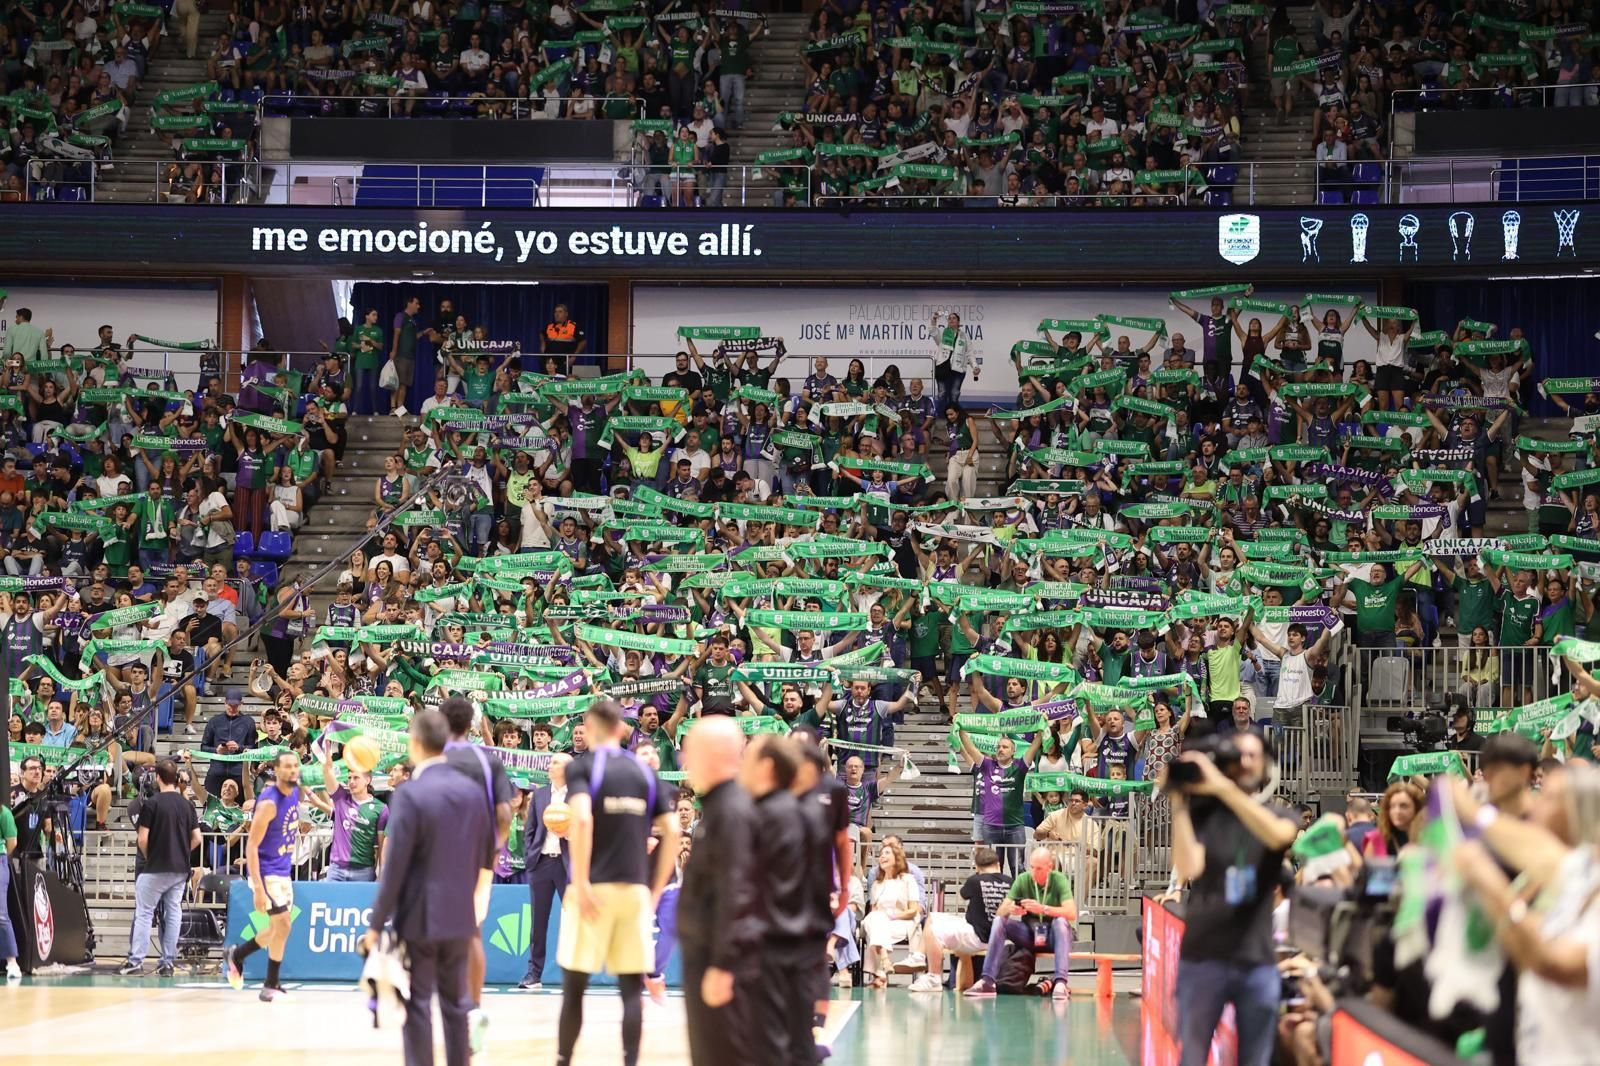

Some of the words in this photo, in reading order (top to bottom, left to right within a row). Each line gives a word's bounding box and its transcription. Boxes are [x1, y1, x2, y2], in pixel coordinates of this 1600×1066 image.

[1526, 28, 1550, 37] Unicaja
[806, 113, 857, 123] UNICAJA
[252, 227, 308, 251] me
[318, 222, 504, 262] emocioné,
[514, 230, 558, 263] yo
[568, 225, 688, 255] estuve
[698, 223, 762, 256] allí.
[850, 304, 899, 321] PALACIO
[903, 304, 918, 321] DE
[799, 322, 831, 340] JOSÉ
[860, 321, 913, 340] MARTÍN
[457, 340, 513, 350] UNICAJA
[723, 338, 779, 350] UNICAJA
[1480, 341, 1510, 349] Unicaja
[1095, 369, 1122, 381] Unicaja
[1154, 370, 1183, 378] Unicaja
[1555, 380, 1584, 389] Unicaja
[649, 387, 676, 395] Unicaja
[1134, 398, 1162, 410] Unicaja
[253, 418, 288, 432] BALONCESTO
[260, 415, 282, 425] UNICAJA
[136, 435, 164, 447] Unicaja
[165, 436, 208, 446] Baloncesto
[1108, 441, 1137, 449] Unicaja
[1044, 454, 1079, 464] BALONCESTO
[1283, 485, 1314, 493] Unicaja
[667, 498, 694, 508] Unicaja
[755, 508, 784, 516] Unicaja
[1303, 498, 1364, 520] UNICAJA
[62, 516, 92, 524] Unicaja
[1075, 529, 1106, 539] Unicaja
[822, 542, 855, 550] Unicaja
[1434, 539, 1492, 548] UNICAJA
[508, 554, 540, 563] Unicaja
[667, 562, 704, 570] BALONCESTO
[15, 577, 64, 586] Baloncesto
[790, 581, 823, 589] Unicaja
[951, 584, 982, 595] Unicaja
[1044, 583, 1072, 591] UNICAJA
[1039, 589, 1078, 597] BALONCESTO
[1086, 589, 1163, 606] UNICAJA
[1204, 597, 1237, 608] Unicaja
[112, 607, 139, 617] UNICAJA
[655, 609, 685, 619] UNICAJA
[1100, 610, 1132, 620] Unicaja
[1289, 608, 1325, 617] Baloncesto
[108, 611, 147, 626] BALONCESTO
[475, 614, 510, 624] Unicaja
[790, 614, 824, 622] Unicaja
[1027, 614, 1060, 623] Unicaja
[374, 625, 410, 634] Unicaja
[621, 630, 655, 644] Unicaja
[401, 640, 474, 656] UNICAJA
[495, 644, 526, 655] UNICAJA
[527, 645, 571, 657] BALONCESTO
[490, 652, 551, 665] Unicaja
[1008, 661, 1046, 672] Unicaja
[451, 672, 479, 680] UNICAJA
[762, 667, 829, 678] Unicaja
[443, 678, 485, 688] BALONCESTO
[611, 685, 638, 695] UNICAJA
[639, 679, 677, 692] BALONCESTO
[492, 679, 569, 699] UNICAJA
[524, 700, 561, 709] Unicaja
[961, 716, 999, 728] UNICAJA
[1000, 714, 1042, 728] CAMPEON
[22, 746, 62, 757] Unicaja
[1413, 756, 1438, 764] Unicaja
[1071, 778, 1108, 789] Unicaja
